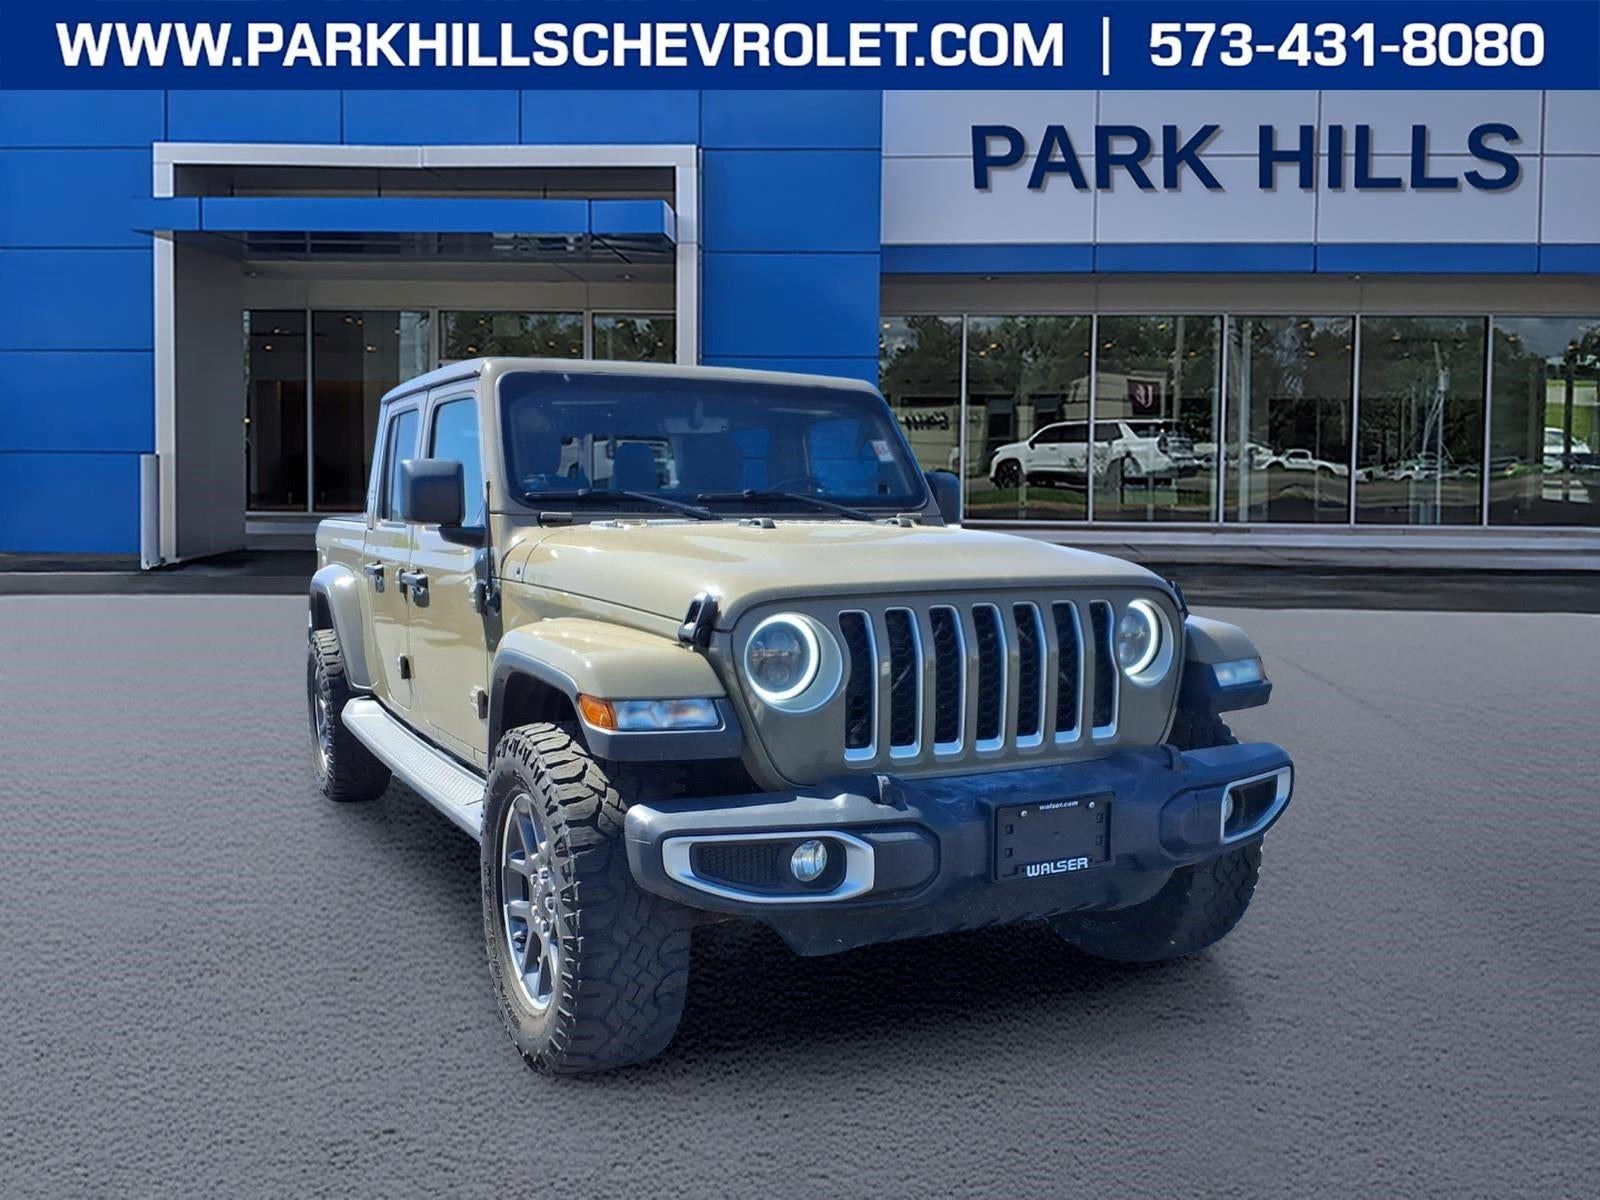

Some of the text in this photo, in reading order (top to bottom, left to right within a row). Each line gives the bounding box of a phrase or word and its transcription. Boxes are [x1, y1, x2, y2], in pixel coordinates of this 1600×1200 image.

[970, 122, 1522, 191] PARK HILLS
[1026, 857, 1089, 878] WALSER
